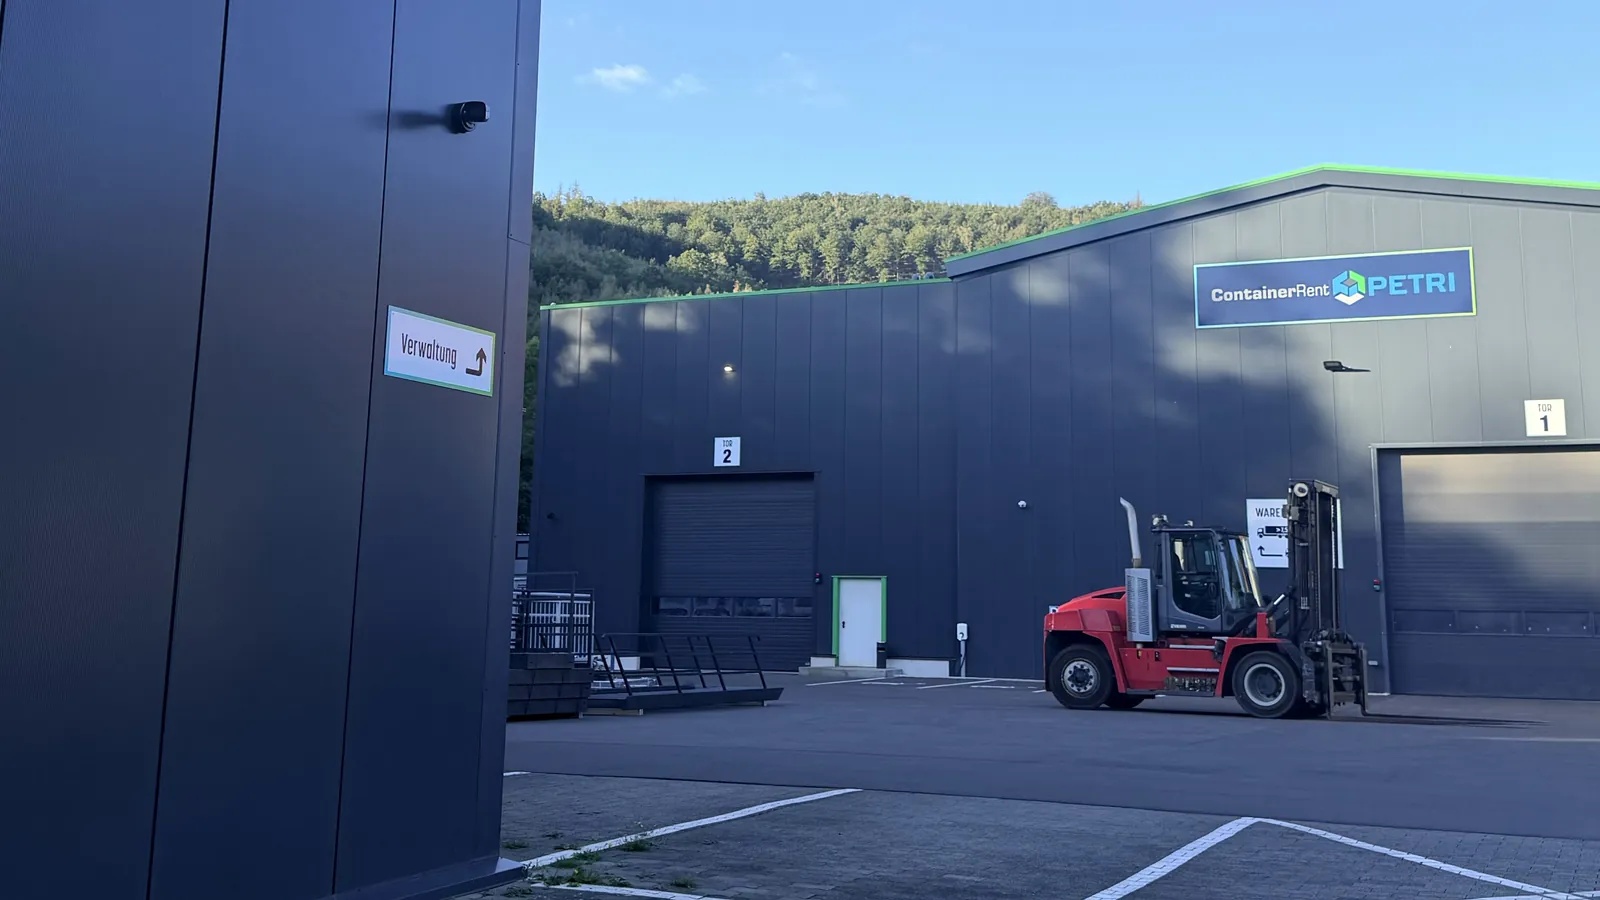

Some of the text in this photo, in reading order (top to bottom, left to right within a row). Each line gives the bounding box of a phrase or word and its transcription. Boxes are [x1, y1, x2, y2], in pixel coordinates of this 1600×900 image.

[1211, 271, 1456, 302] ContainerRent PETRI
[401, 332, 457, 370] Verwaltung
[1537, 403, 1552, 412] TOR
[1539, 414, 1549, 431] 1
[722, 448, 732, 463] 2
[1255, 507, 1281, 518] WARE
